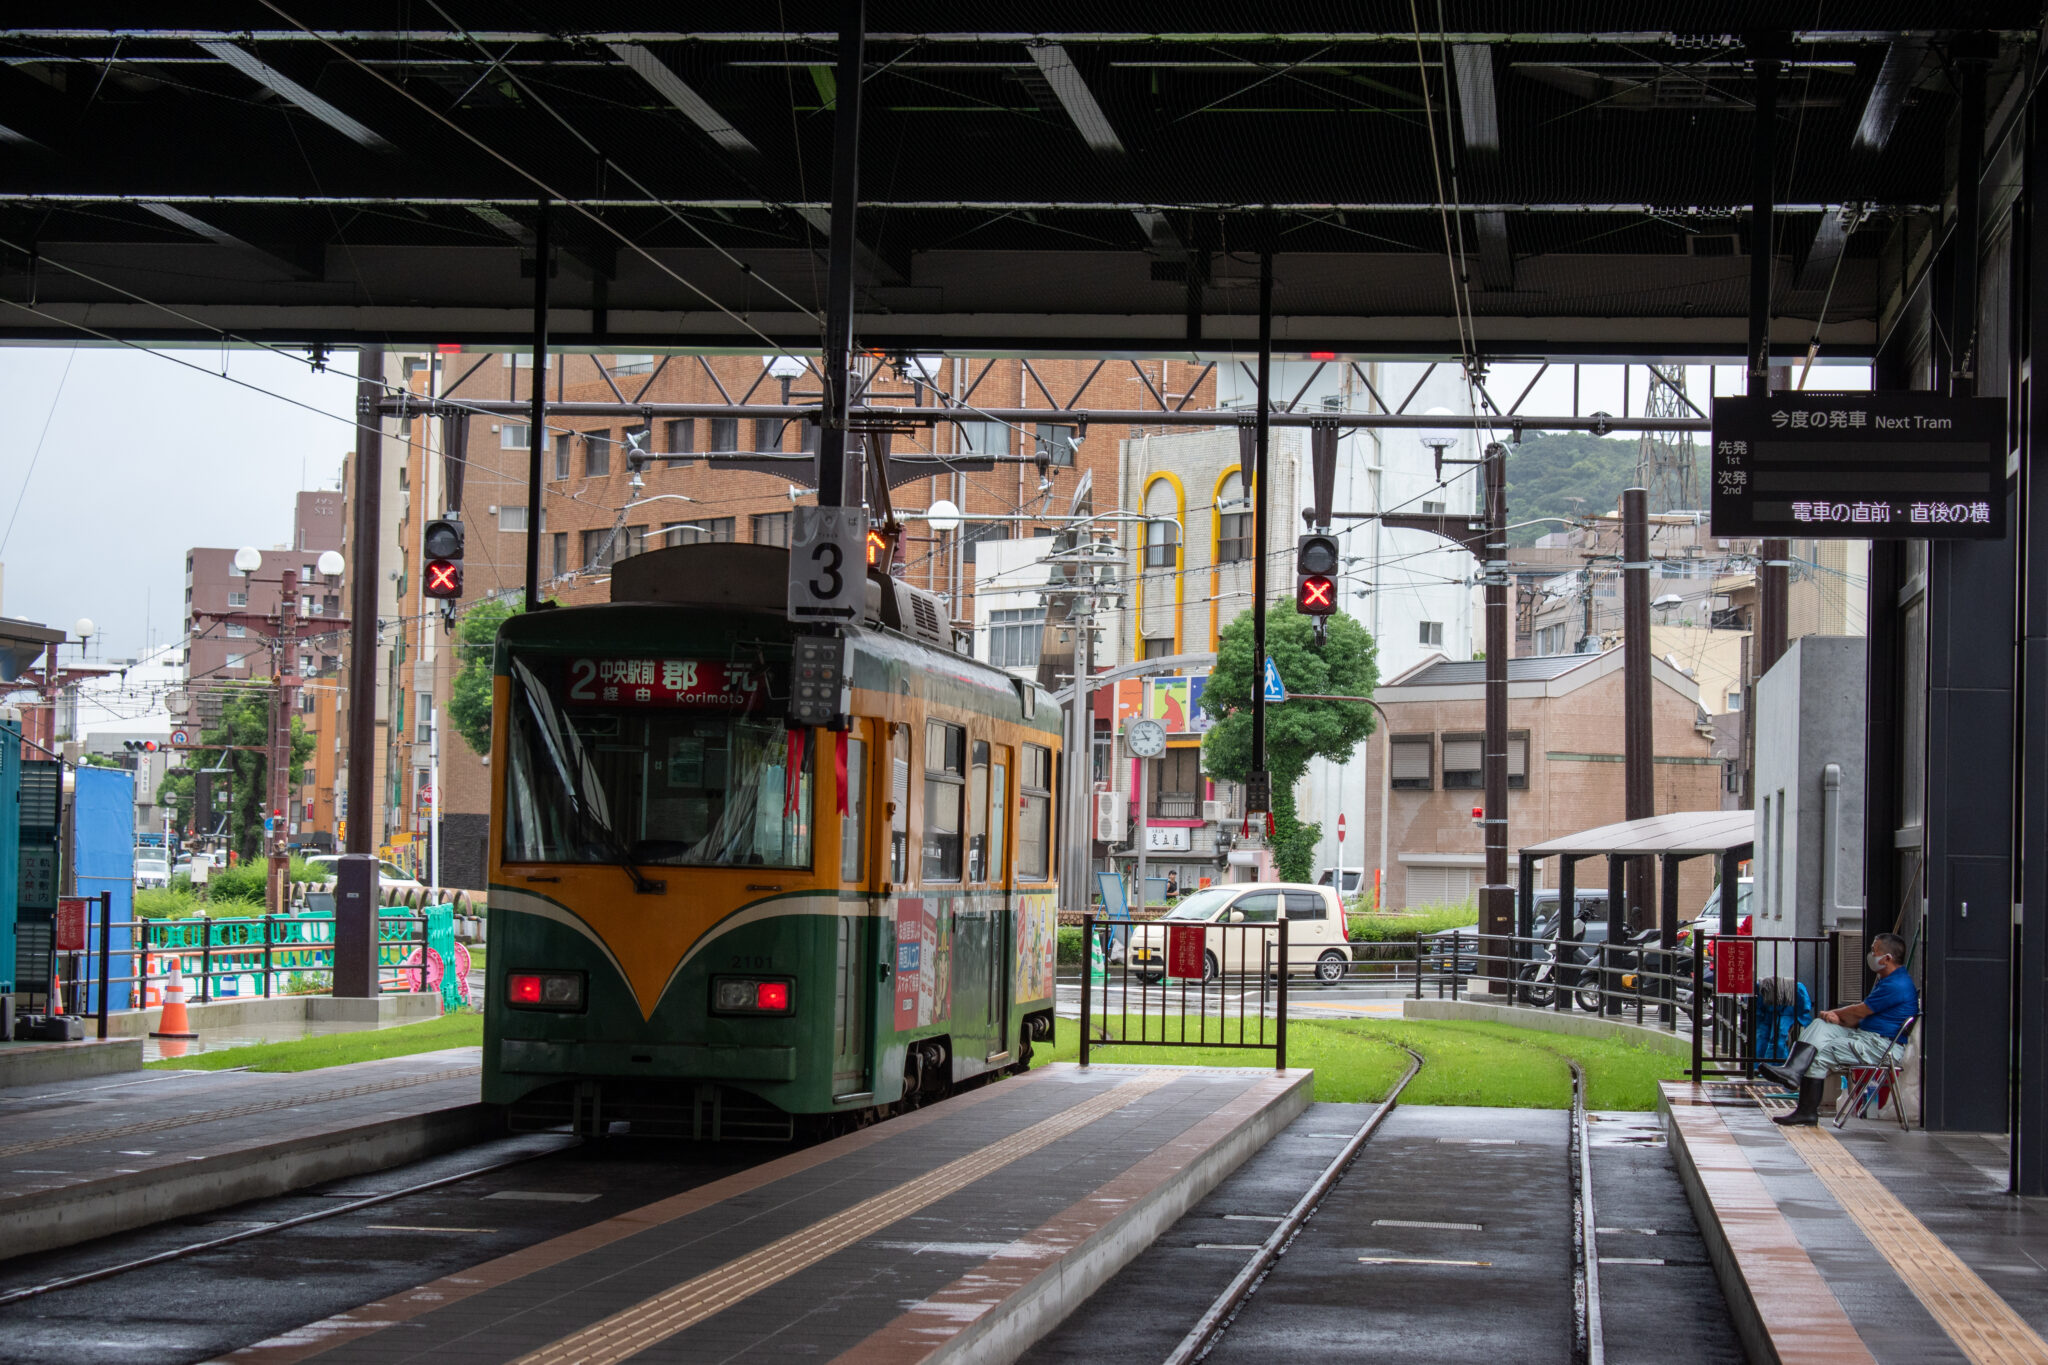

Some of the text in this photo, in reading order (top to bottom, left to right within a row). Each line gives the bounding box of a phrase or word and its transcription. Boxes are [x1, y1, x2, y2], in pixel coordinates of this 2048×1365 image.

[1771, 410, 1952, 429] 今度の発車 Next Tram
[1718, 440, 1748, 455] 先発
[1725, 455, 1741, 465] 1st
[1718, 470, 1747, 485] 次発
[1722, 485, 1742, 495] 2nd
[1791, 502, 1990, 523] 電車の直前・直後の横
[809, 542, 843, 600] 3
[570, 658, 597, 700] 2
[600, 660, 655, 685] 中央駅前
[603, 687, 651, 702] 経由
[676, 691, 744, 704] Korimoto
[24, 857, 35, 902] 立入禁止
